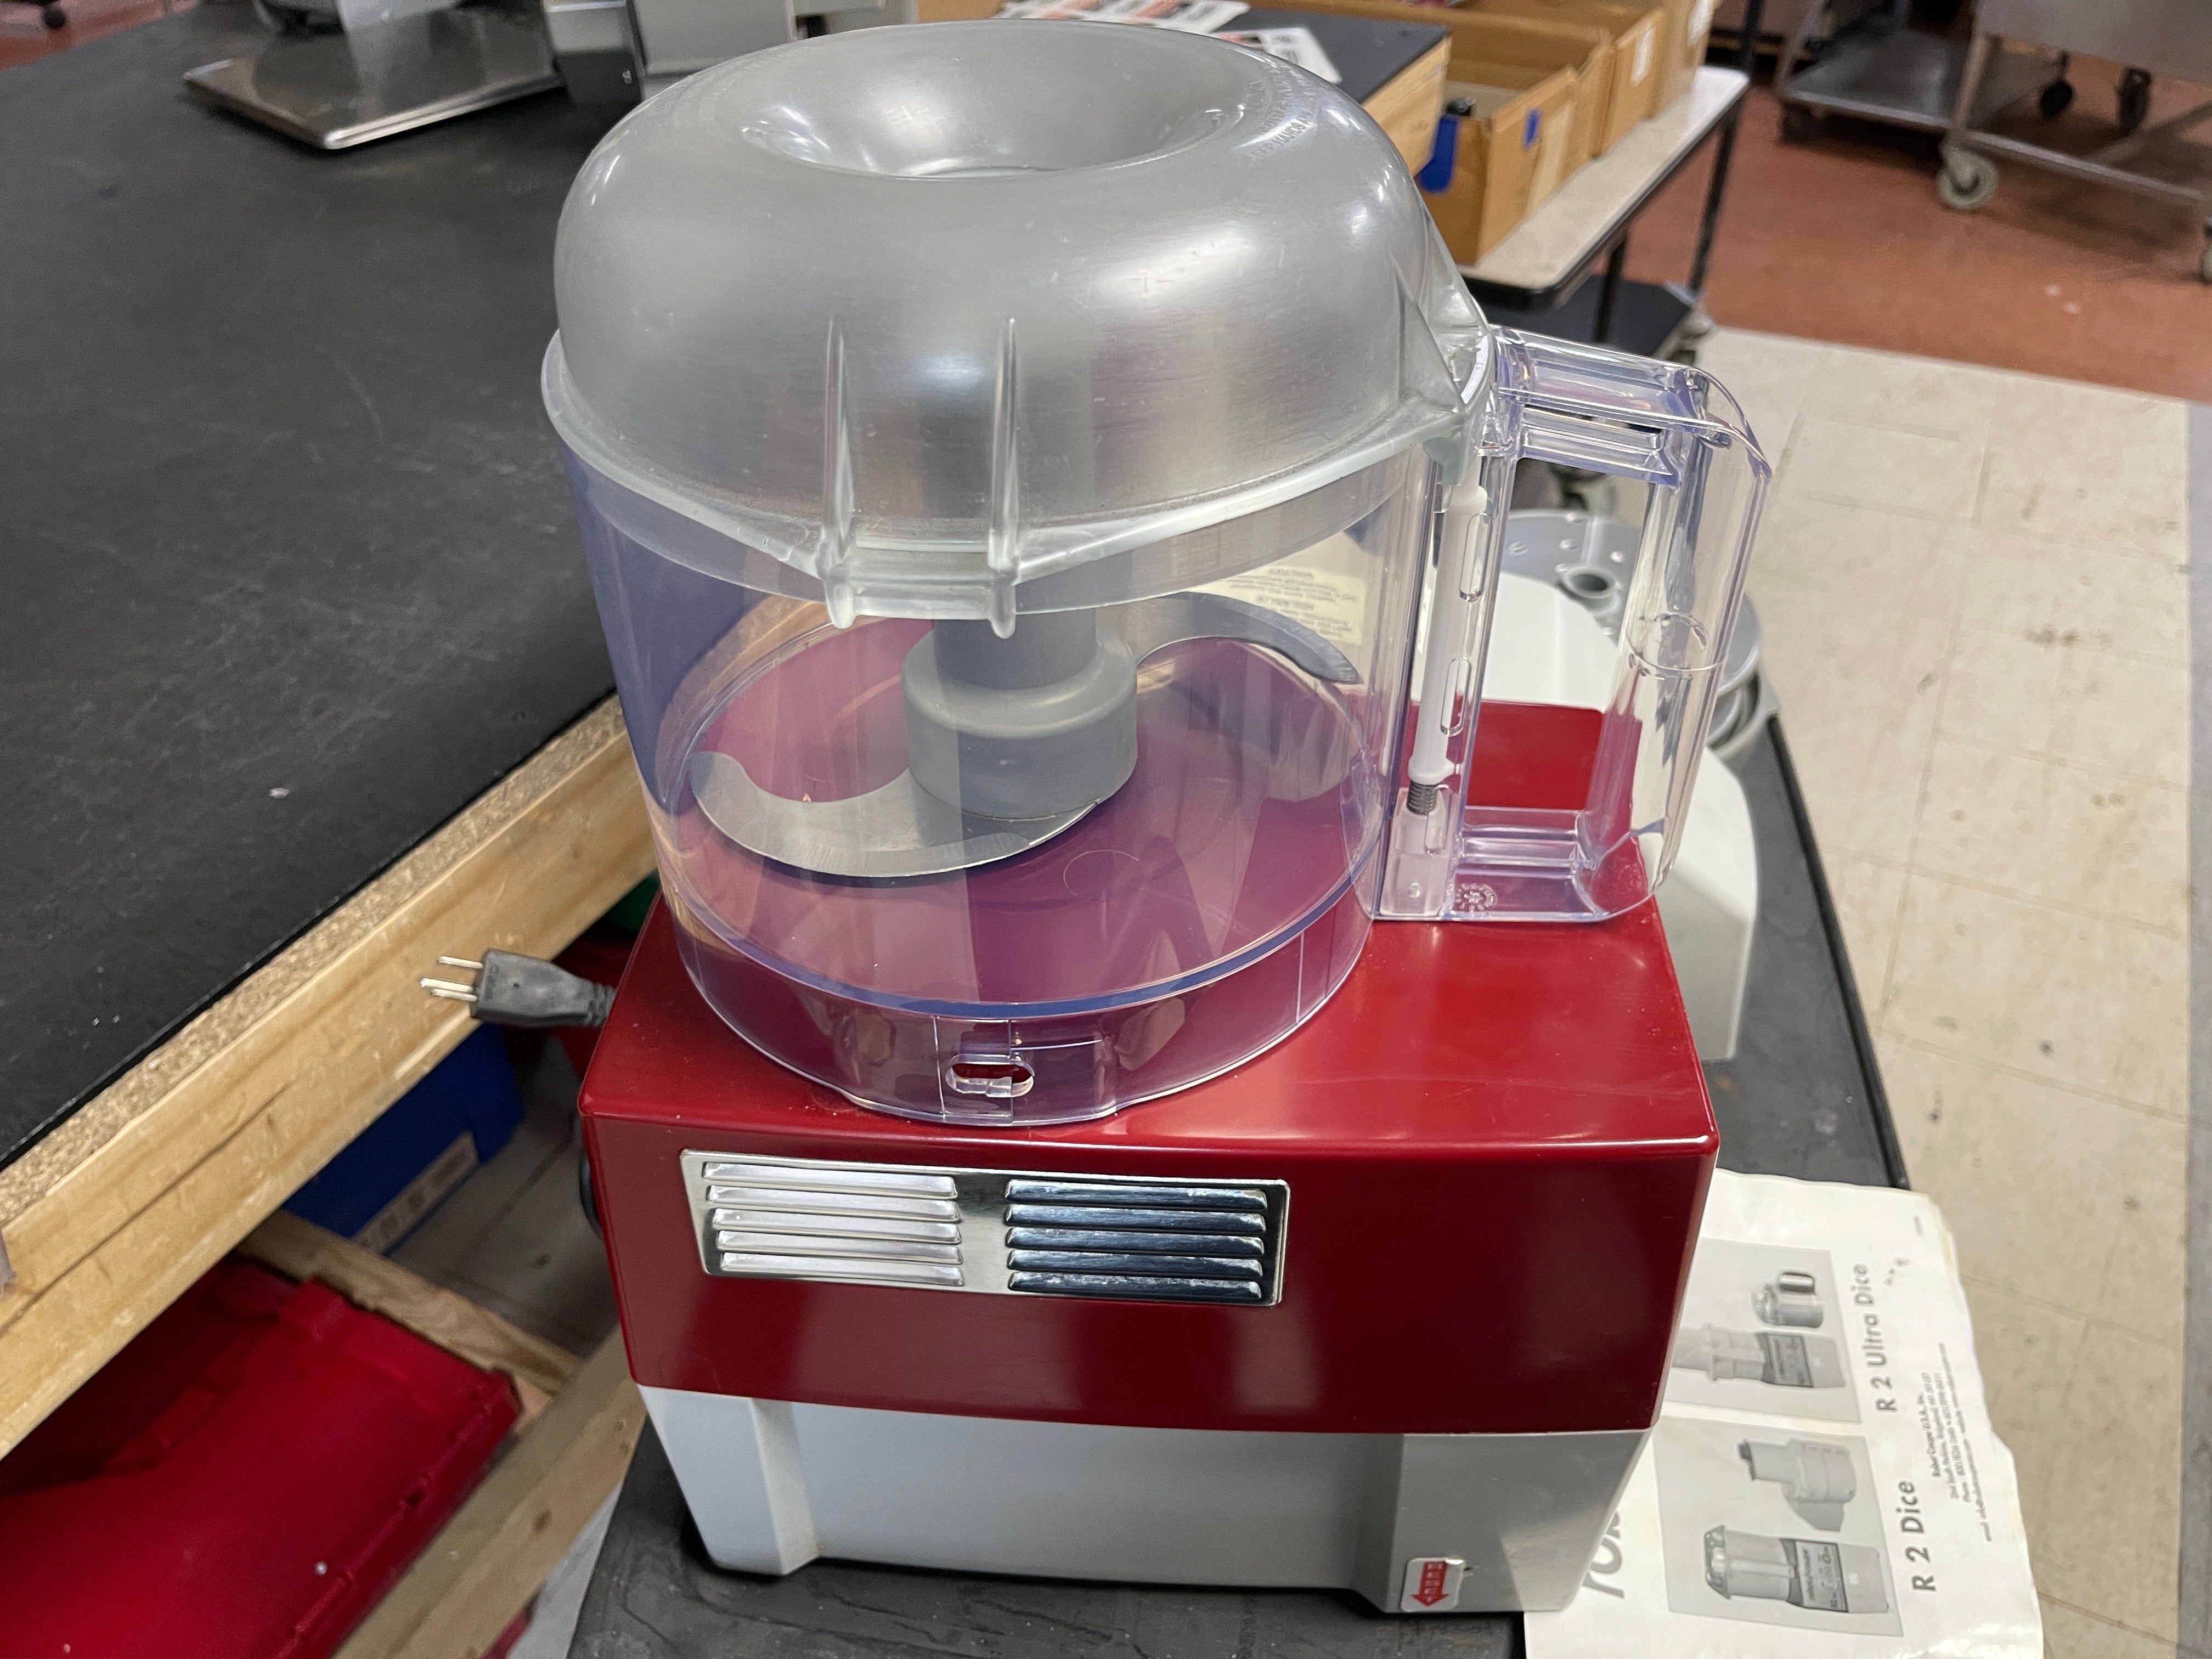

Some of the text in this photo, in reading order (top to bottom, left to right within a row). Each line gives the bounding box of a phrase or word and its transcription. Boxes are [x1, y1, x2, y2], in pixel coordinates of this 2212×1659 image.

[1850, 1263, 1897, 1411] R 2 Ultra Dice
[1895, 1481, 1936, 1591] R 2 Dice
